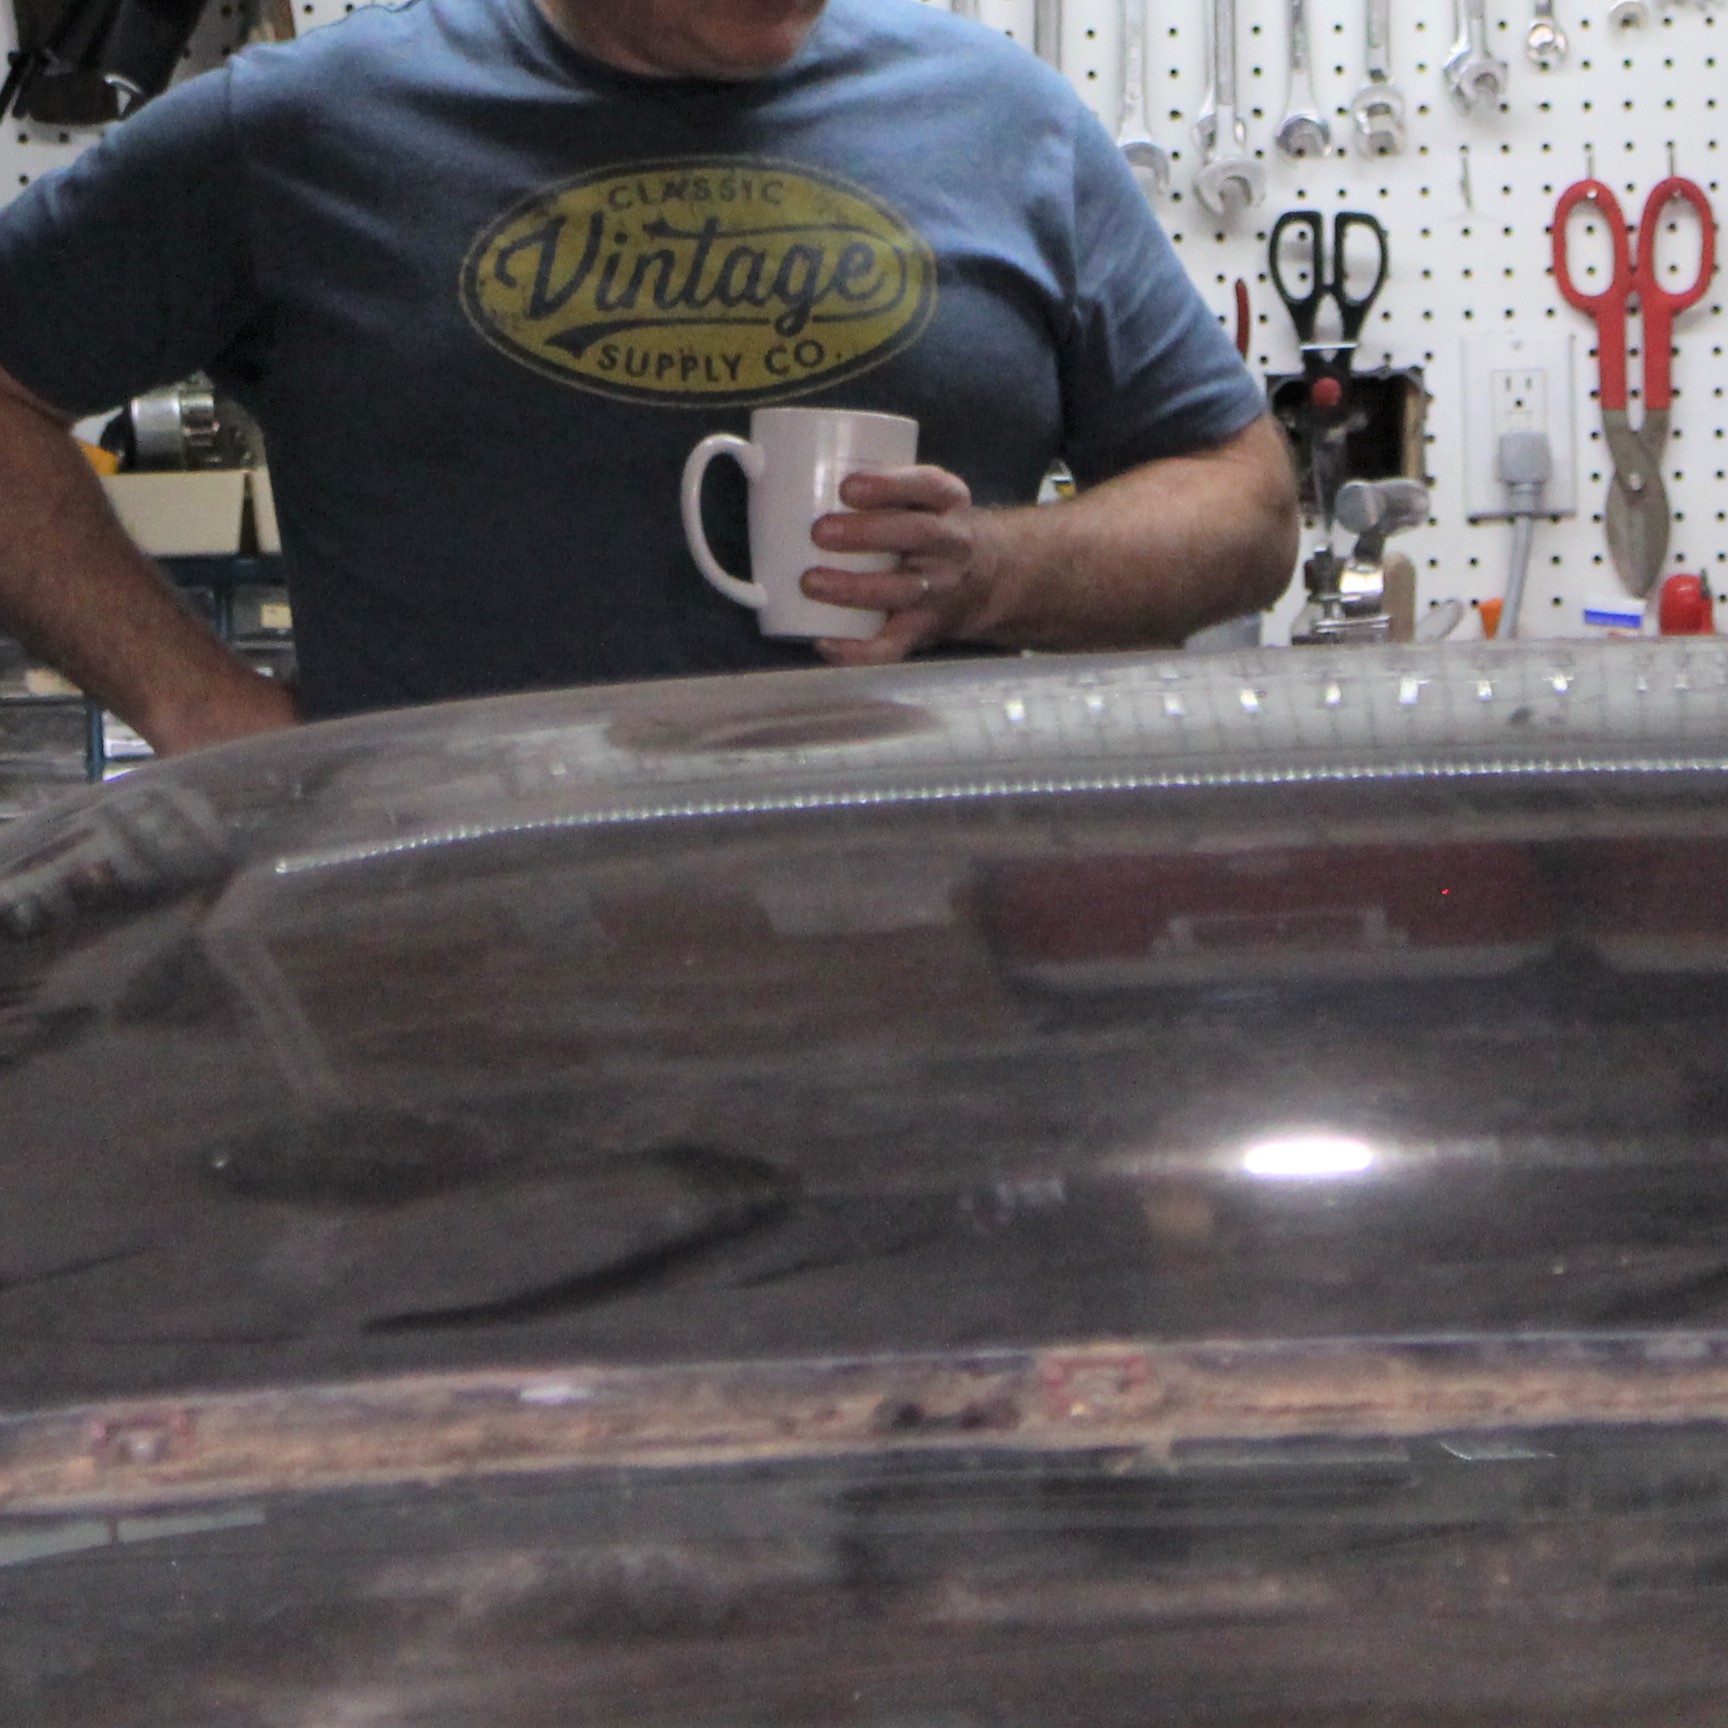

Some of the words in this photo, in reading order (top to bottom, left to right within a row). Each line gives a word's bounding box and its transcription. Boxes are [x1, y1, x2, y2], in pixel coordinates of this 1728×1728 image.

[607, 176, 784, 210] CLASSIC
[494, 211, 888, 338] Vintage
[597, 344, 742, 382] SUPPLY
